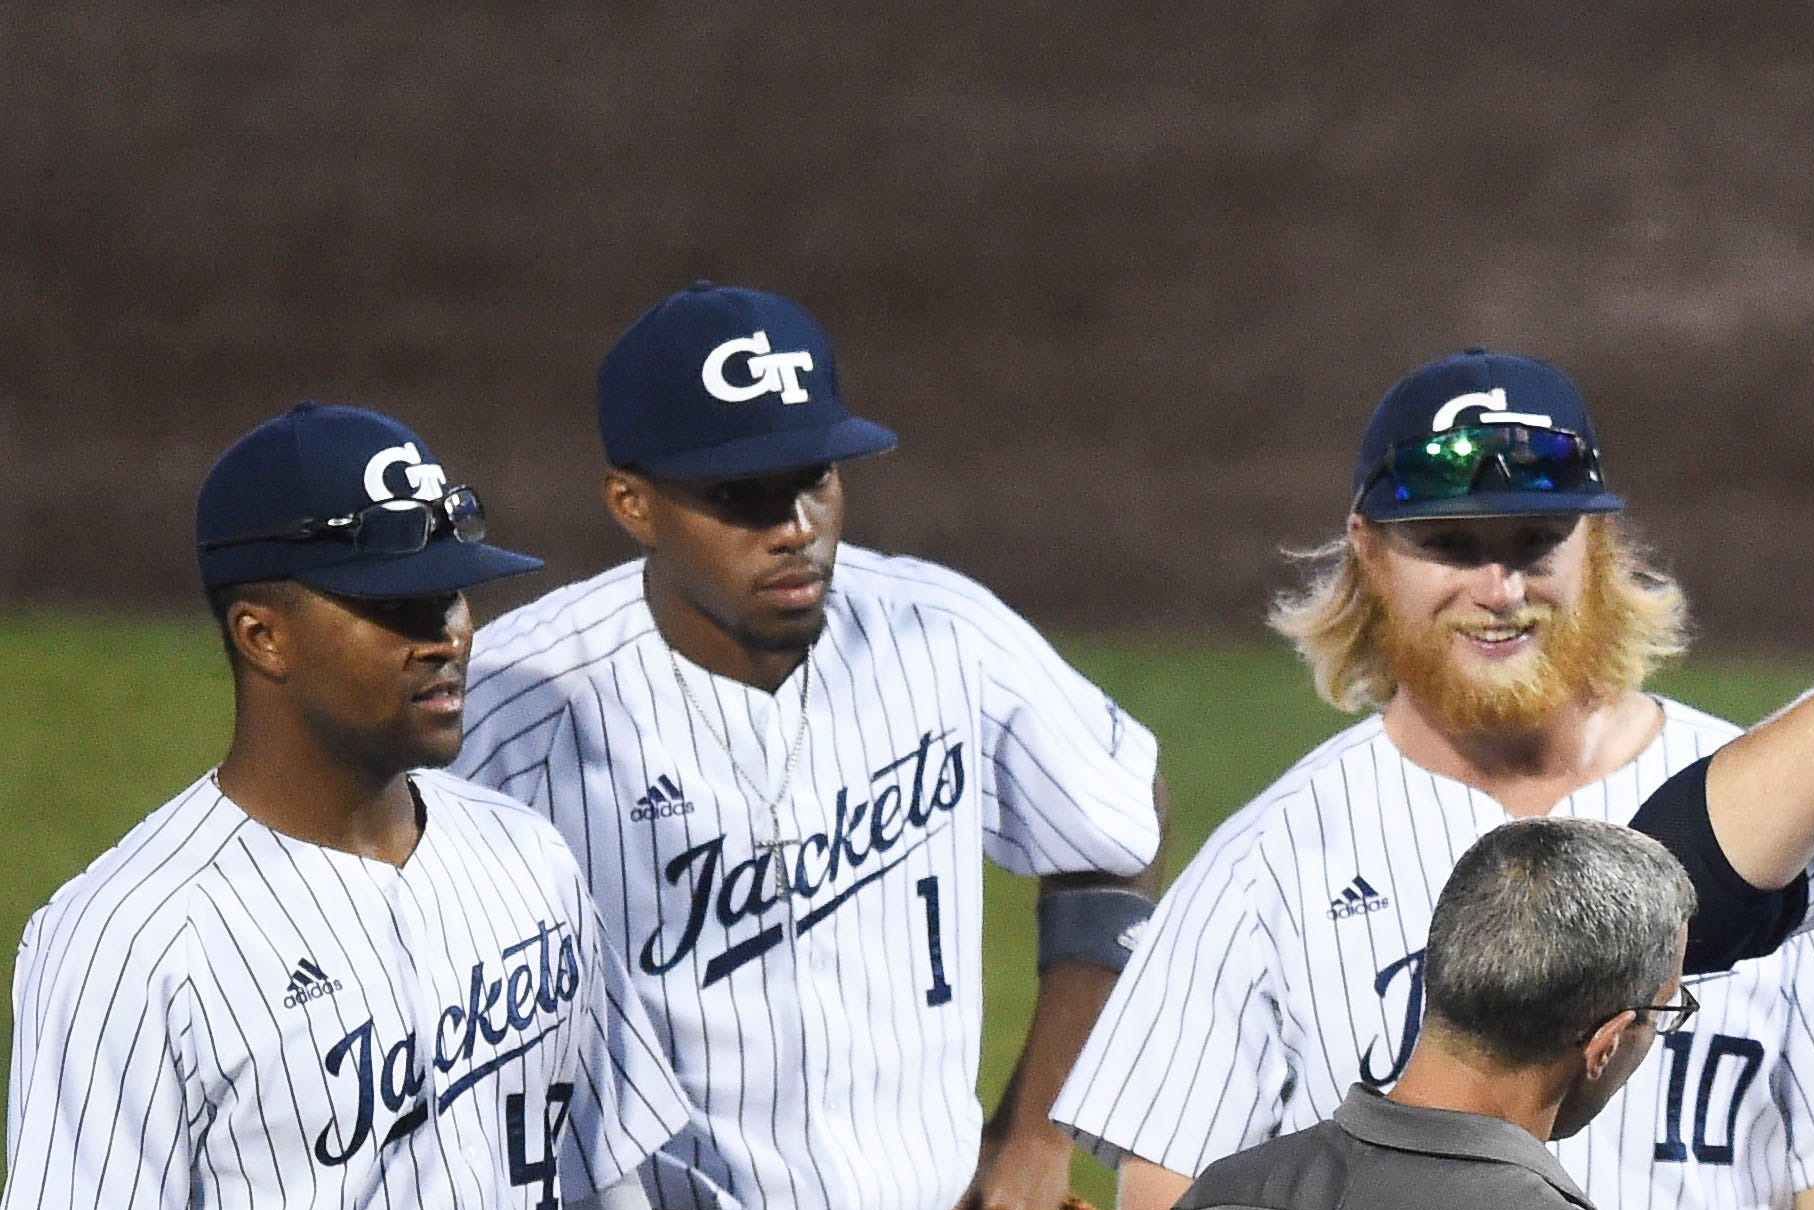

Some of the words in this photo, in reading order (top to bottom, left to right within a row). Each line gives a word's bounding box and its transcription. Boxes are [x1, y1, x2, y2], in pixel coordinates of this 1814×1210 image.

[702, 330, 814, 405] GT
[630, 800, 695, 823] adidas
[639, 730, 966, 977] Jackets
[916, 875, 953, 1008] 1
[1326, 896, 1390, 921] adidas
[283, 977, 344, 1010] adidas
[314, 919, 580, 1168] Jackets
[1653, 1030, 1765, 1166] 10
